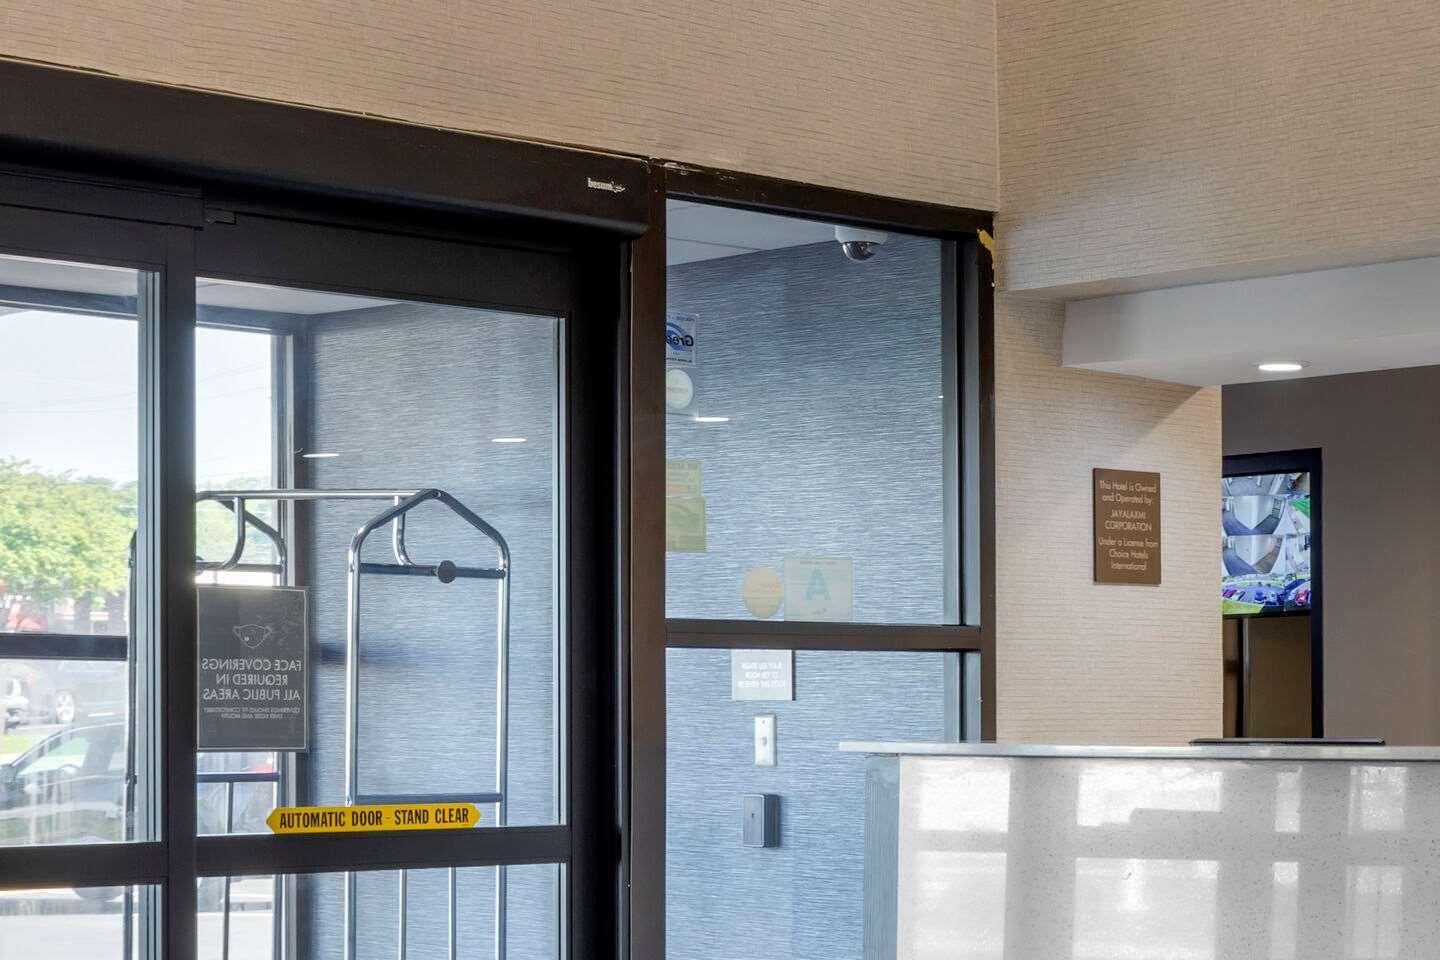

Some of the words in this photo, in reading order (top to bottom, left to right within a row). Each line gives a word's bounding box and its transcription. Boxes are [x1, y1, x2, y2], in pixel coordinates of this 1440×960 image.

[1104, 519, 1153, 532] CORPORATION
[279, 810, 346, 829] AUTOMATIC
[351, 810, 383, 826] DOOR
[394, 808, 429, 825] STAND
[434, 807, 469, 824] CLEAR
